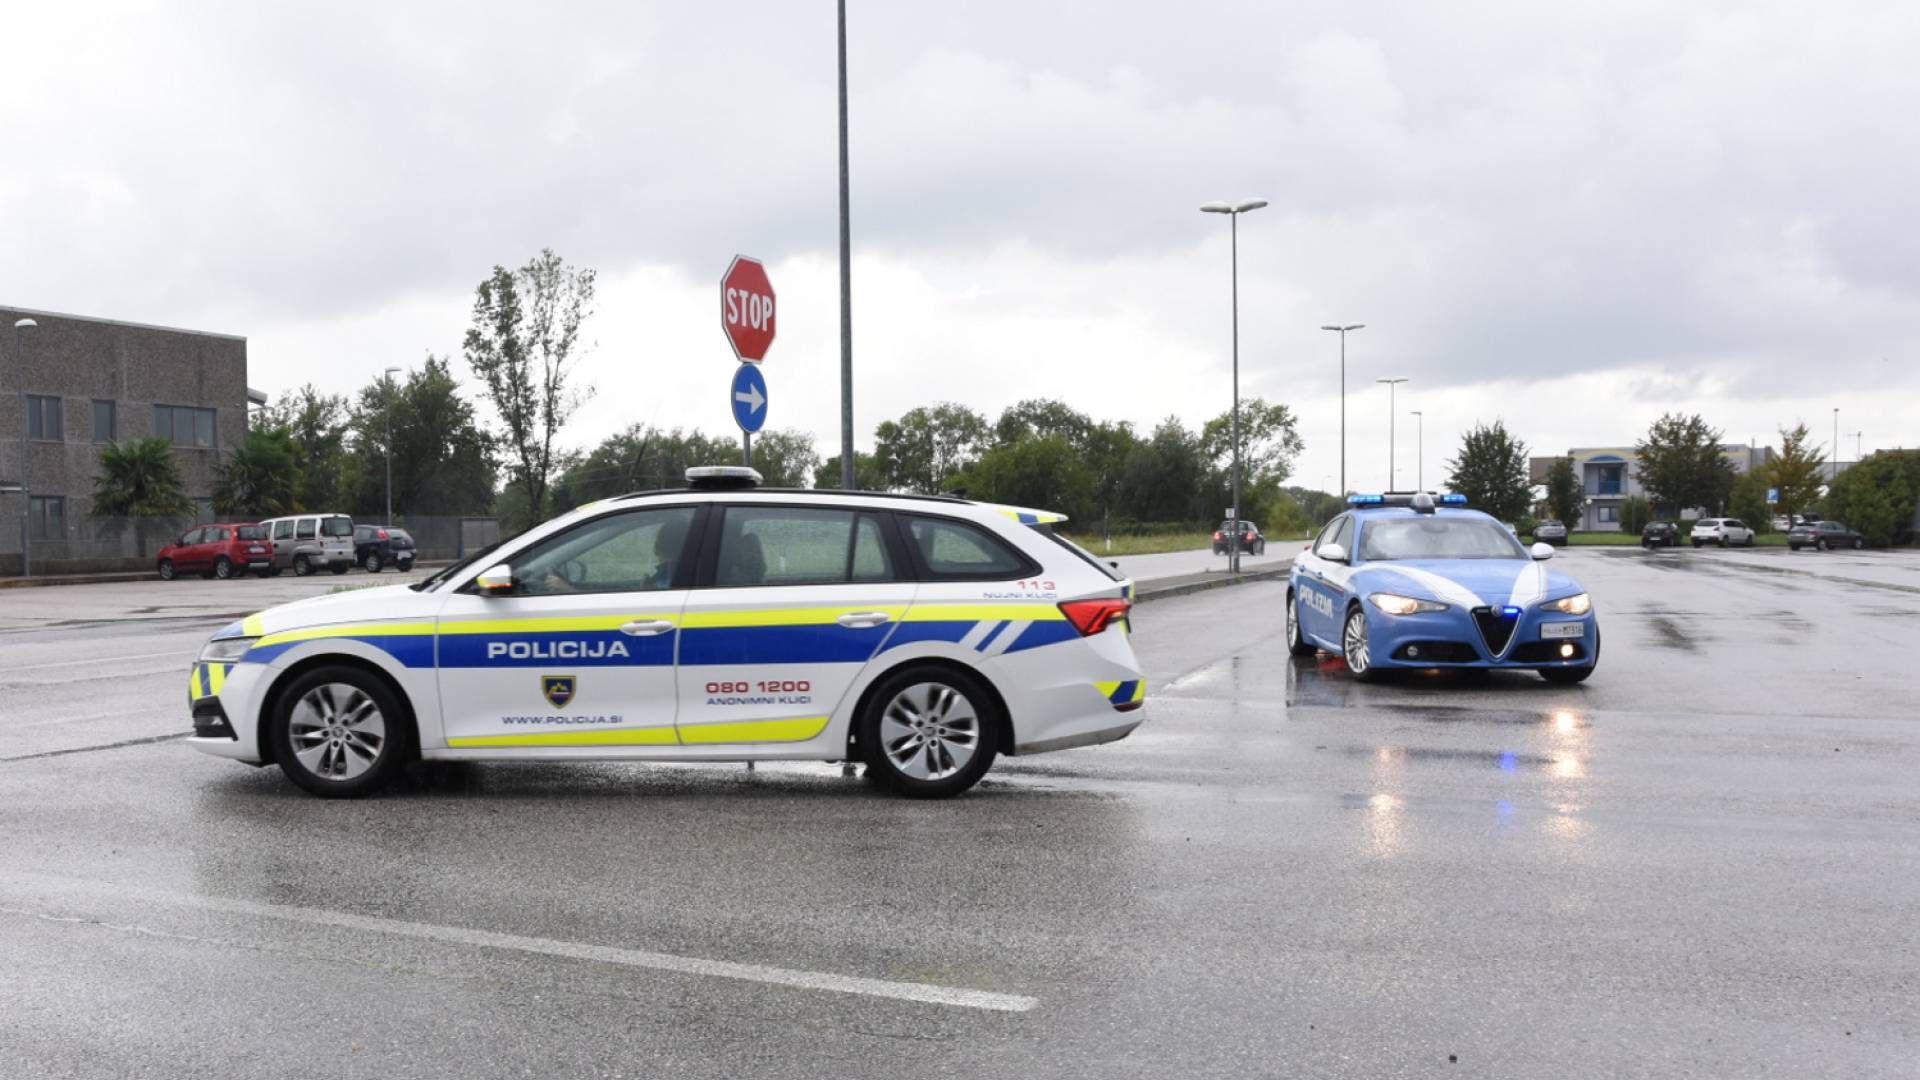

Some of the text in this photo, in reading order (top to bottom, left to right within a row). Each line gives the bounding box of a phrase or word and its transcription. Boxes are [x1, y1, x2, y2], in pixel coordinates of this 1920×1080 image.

[727, 288, 772, 331] STOP
[1017, 581, 1056, 590] 113
[1300, 584, 1333, 619] POLIZIA
[488, 640, 630, 659] POLICIJA
[705, 680, 810, 694] 080 1200
[706, 695, 812, 706] ANONIMNI KLICI
[502, 715, 623, 725] WWW.POLICIJA.SI
